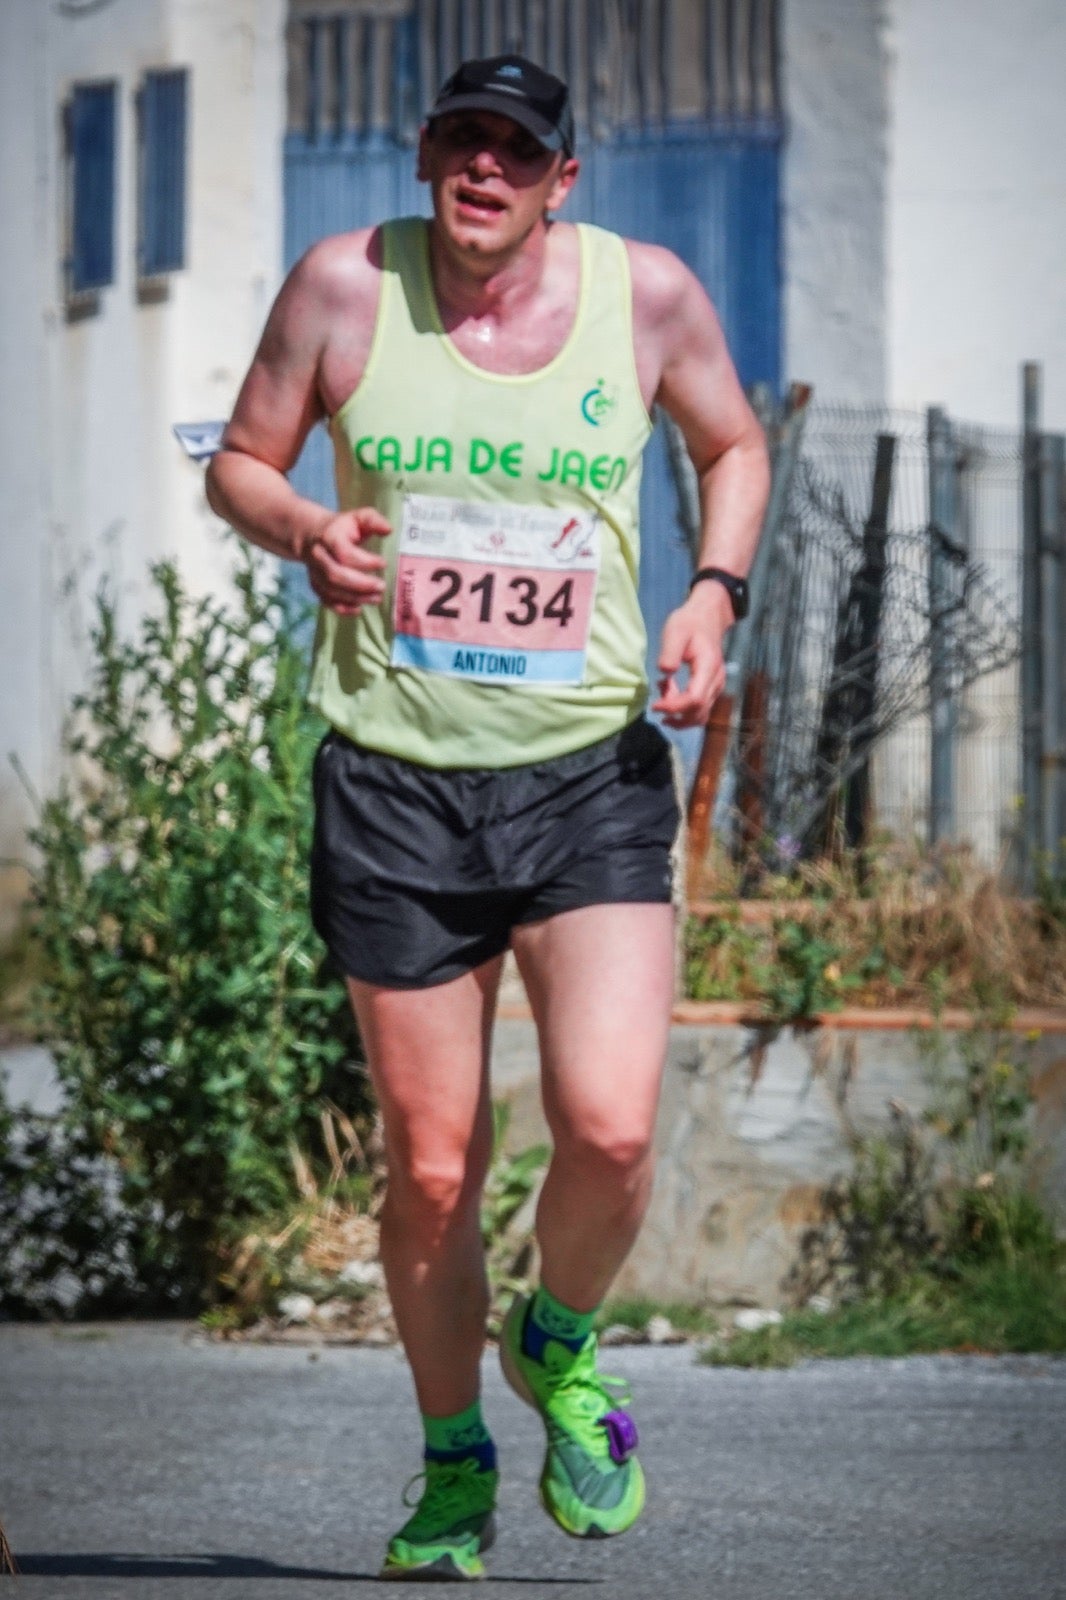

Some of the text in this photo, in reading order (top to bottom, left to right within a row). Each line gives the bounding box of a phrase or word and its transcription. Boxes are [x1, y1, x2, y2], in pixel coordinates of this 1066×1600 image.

[355, 435, 453, 472] CAJA
[469, 437, 524, 478] DE
[426, 566, 574, 628] 2134
[453, 649, 527, 676] ANTONIO
